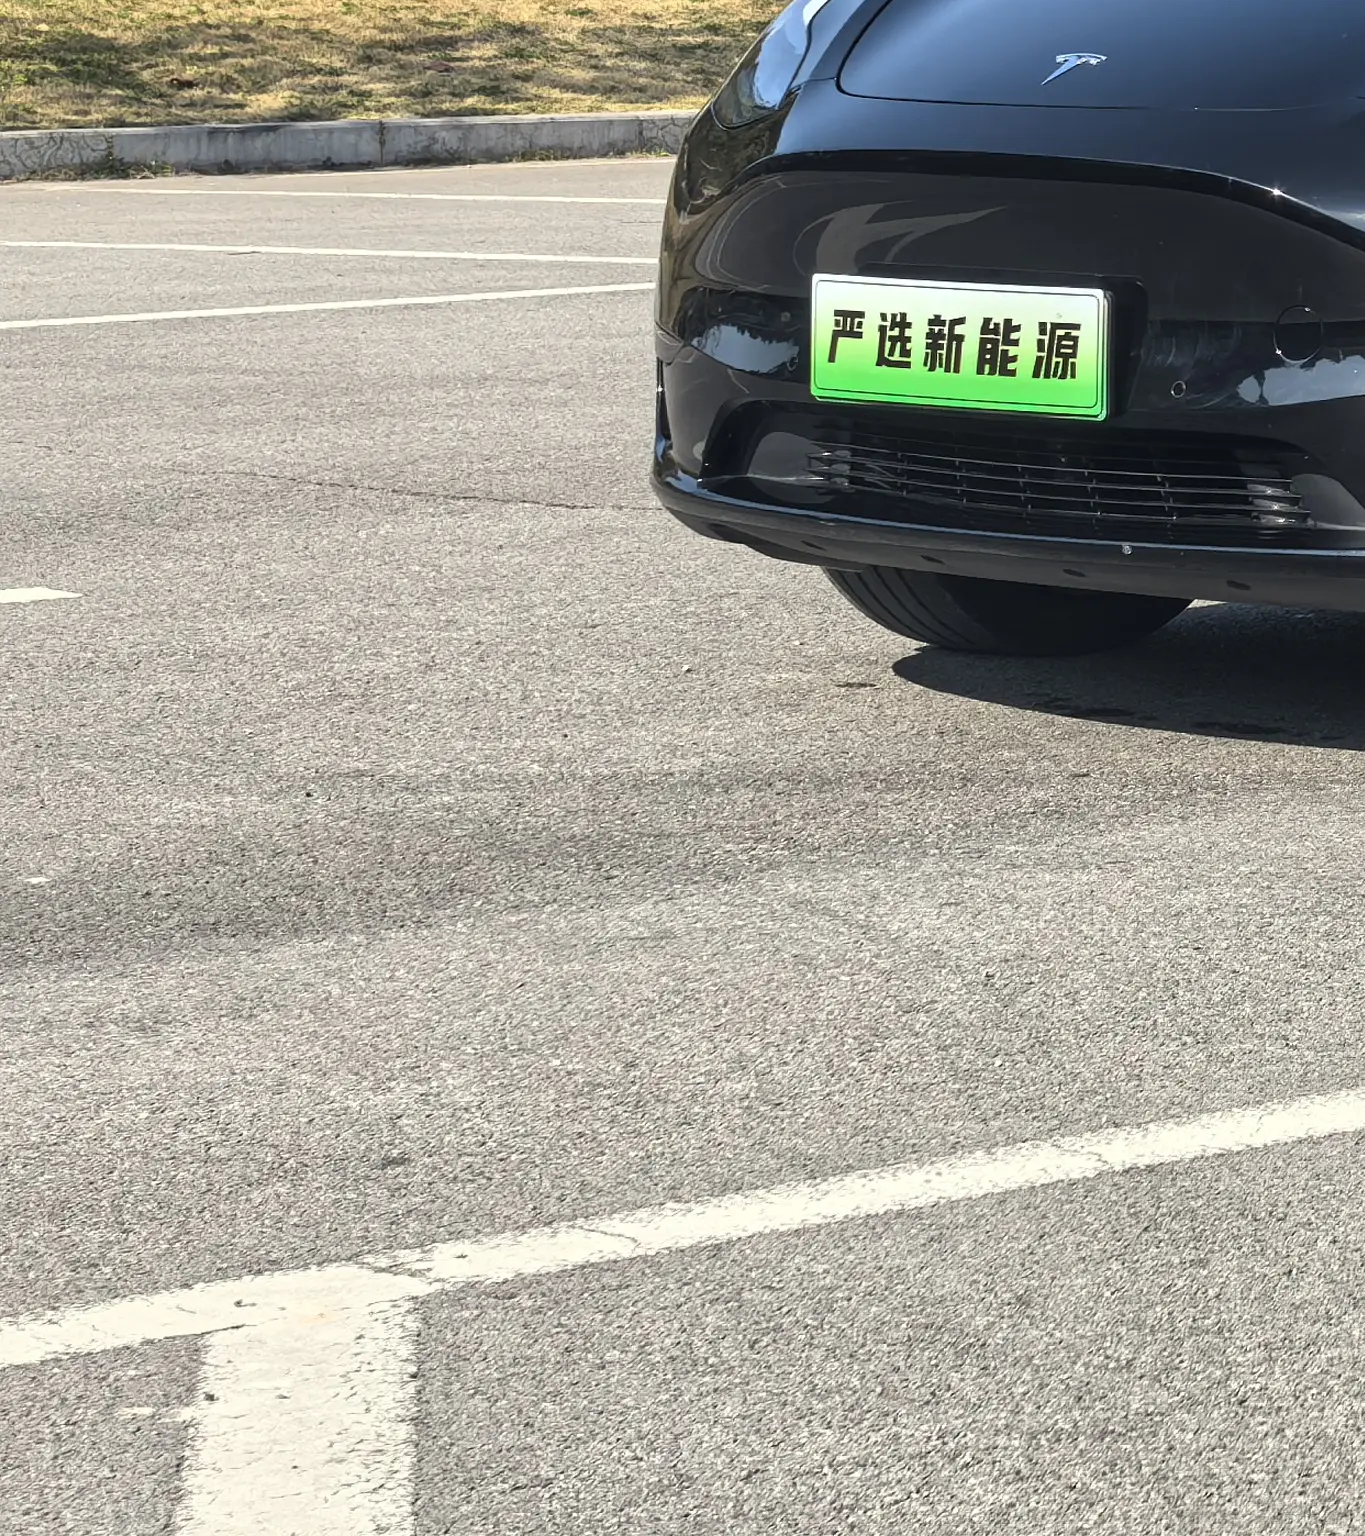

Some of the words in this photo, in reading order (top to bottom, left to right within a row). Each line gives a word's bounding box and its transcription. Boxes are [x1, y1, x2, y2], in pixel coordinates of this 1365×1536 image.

[828, 309, 1082, 380] 严选新能源
